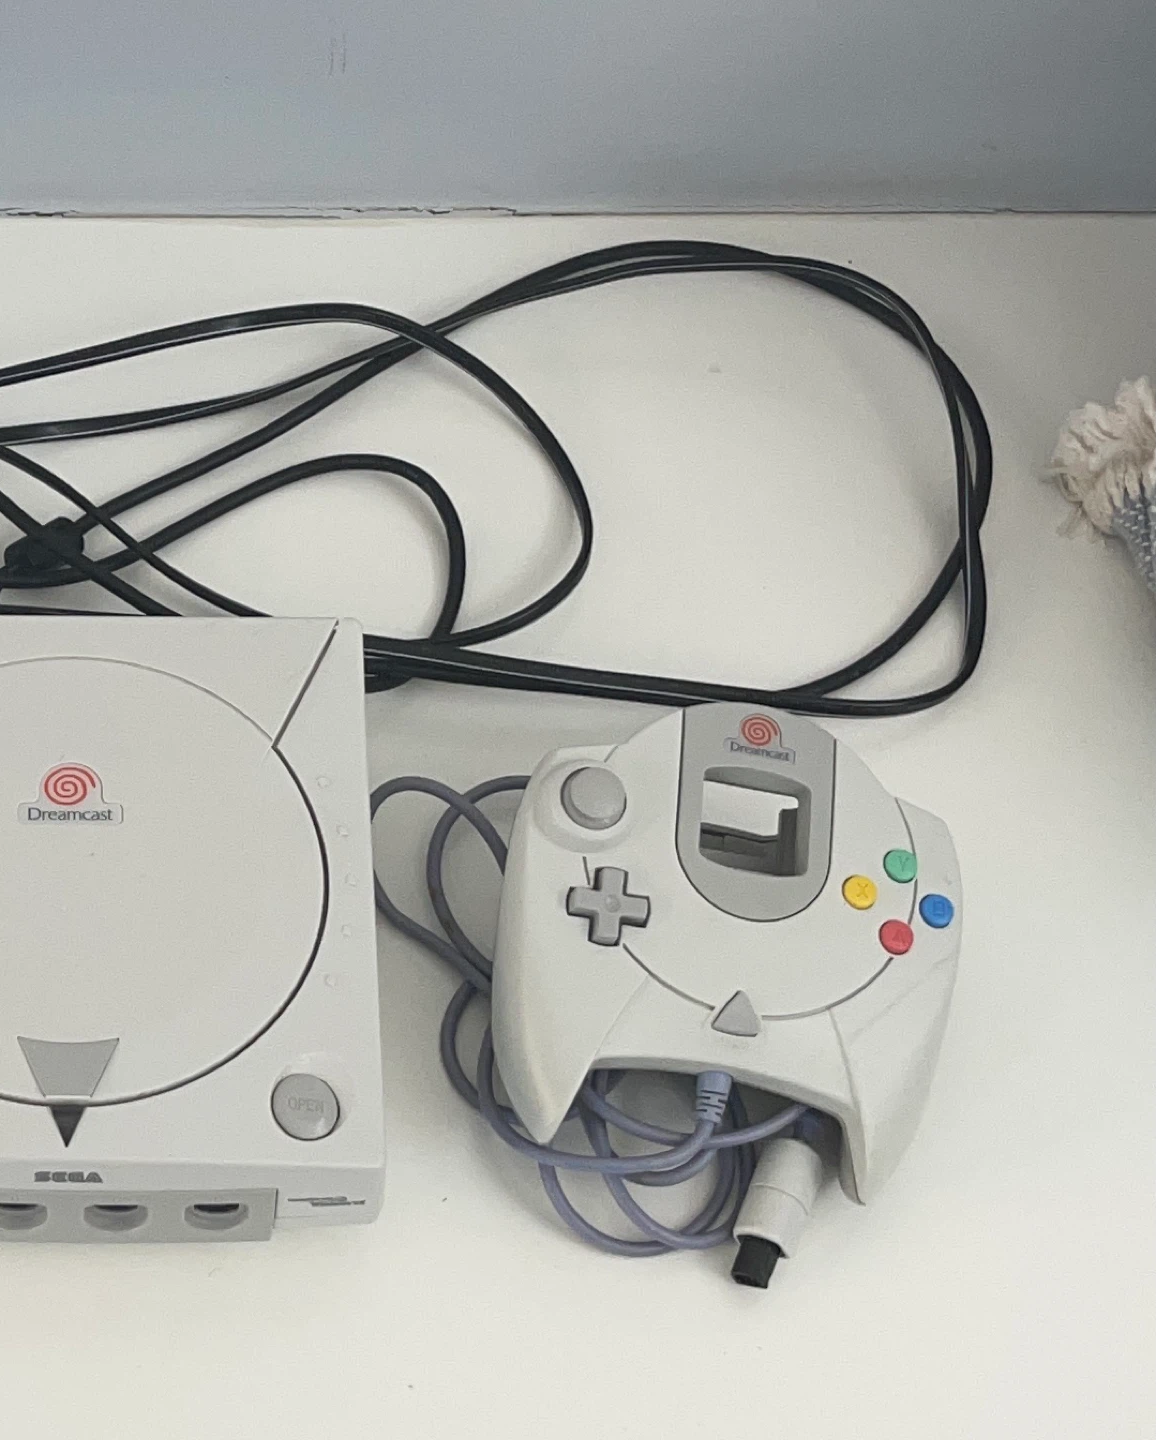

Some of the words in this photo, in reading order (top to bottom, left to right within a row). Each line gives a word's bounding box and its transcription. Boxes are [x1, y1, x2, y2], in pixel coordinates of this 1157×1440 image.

[730, 740, 790, 762] Dreamcast
[27, 807, 114, 821] Dreamcast
[856, 881, 870, 899] X
[287, 1096, 325, 1114] OPEN
[33, 1170, 104, 1184] SEGA
